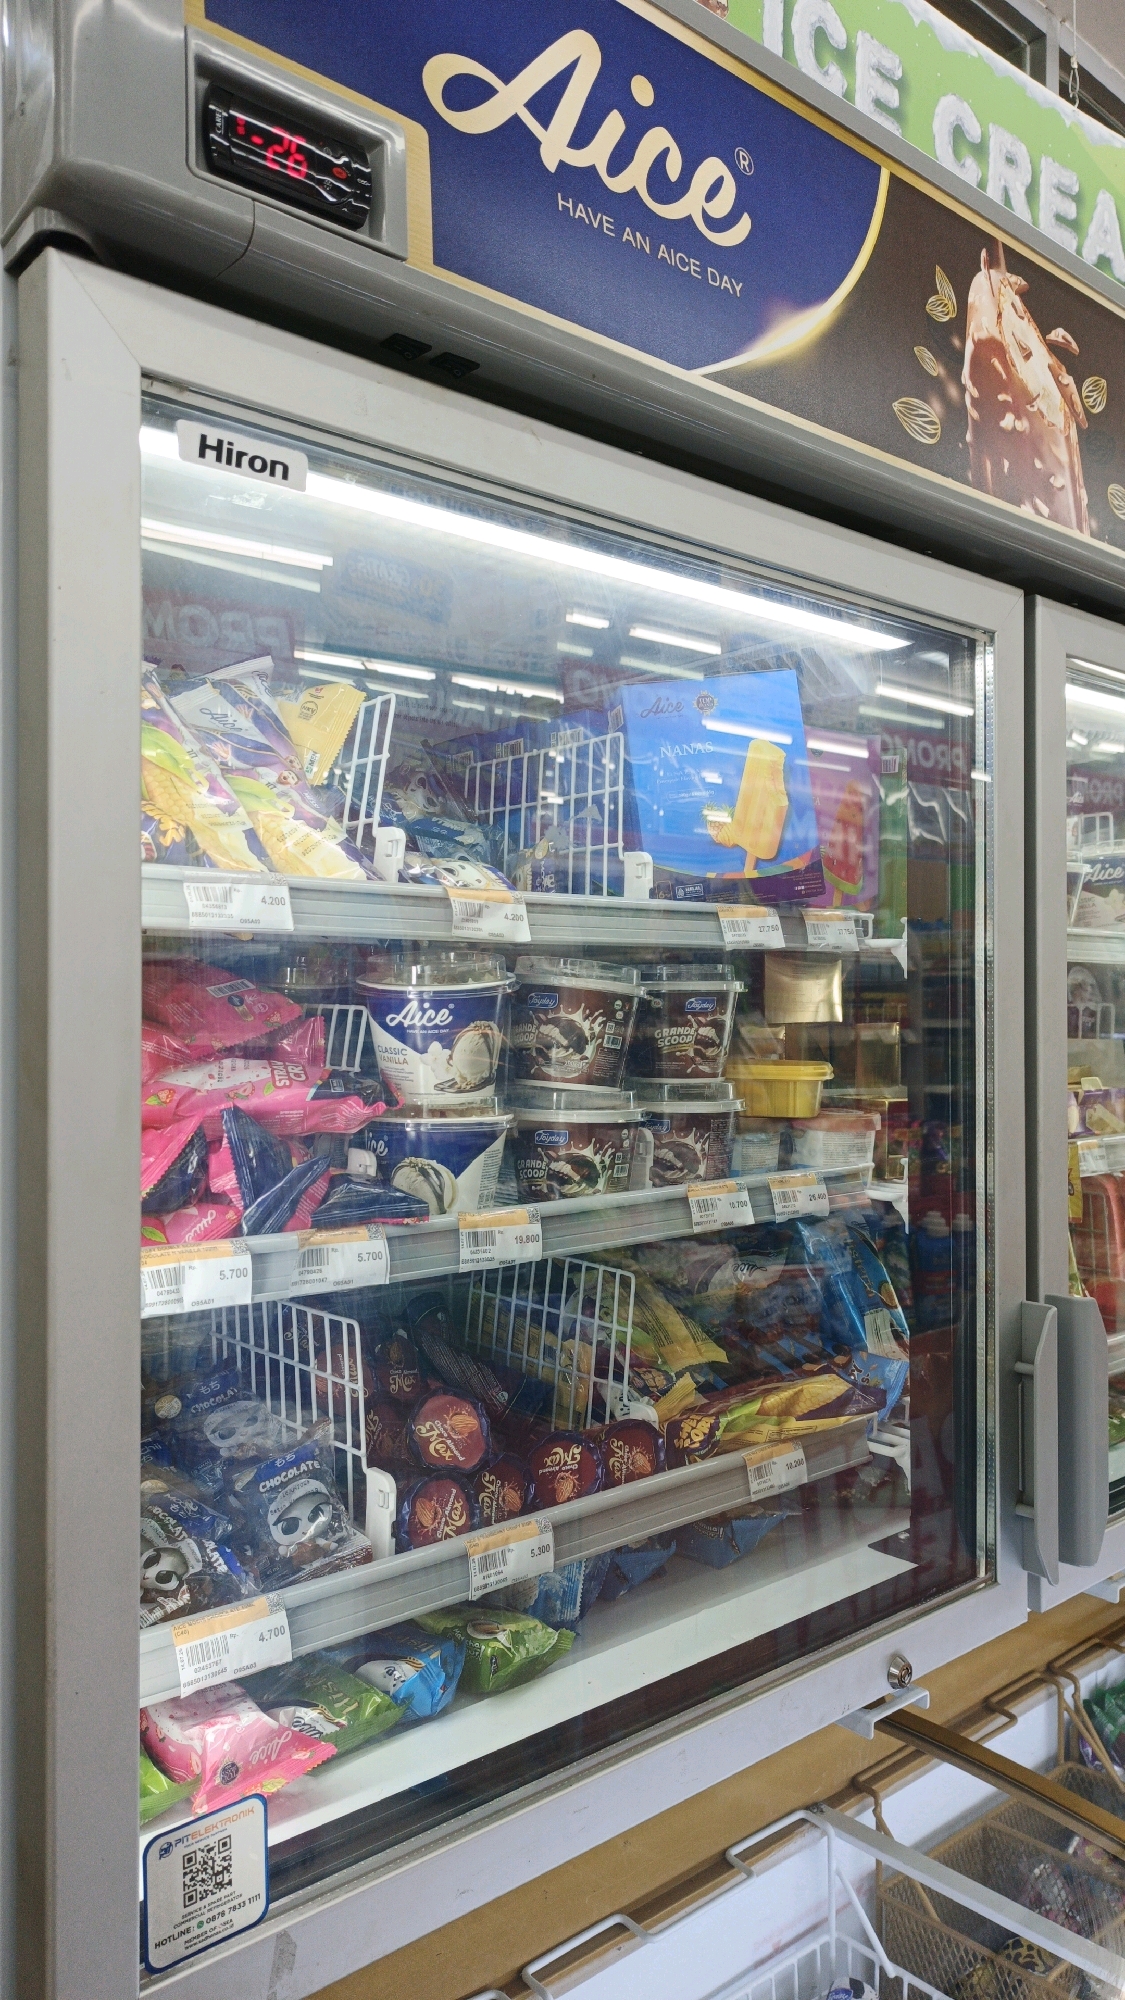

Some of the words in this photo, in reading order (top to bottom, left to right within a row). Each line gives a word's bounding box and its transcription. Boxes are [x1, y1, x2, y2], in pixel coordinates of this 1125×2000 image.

[763, 0, 903, 138] ICE
[422, 29, 751, 247] Aice
[557, 193, 615, 237] HAVE
[622, 227, 650, 254] AN
[658, 244, 702, 279] AICE
[707, 267, 743, 297] DAY
[198, 434, 289, 480] Hiron
[641, 697, 685, 718] Aice
[660, 742, 713, 758] NANAS
[261, 896, 286, 906] 4.200
[386, 1001, 453, 1028] Aice
[655, 1026, 696, 1039] GRANDE
[657, 1035, 693, 1048] SCOOP
[378, 1045, 408, 1057] CLASSIC
[379, 1056, 409, 1067] VANILLA
[517, 1158, 547, 1170] GRANDE
[519, 1168, 546, 1180] SCOOP
[514, 1233, 540, 1244] 19.800
[357, 1251, 383, 1262] 5.700
[219, 1267, 248, 1280] 5.700
[416, 1421, 454, 1461] Max
[434, 1420, 448, 1438] Choco
[445, 1437, 466, 1461] Almond
[274, 1453, 296, 1468] もち
[544, 1443, 582, 1467] Max
[259, 1459, 321, 1493] CHOCOLATE
[436, 1517, 446, 1539] Choco
[444, 1488, 457, 1516] Almond
[530, 1544, 551, 1558] 5.300
[258, 1625, 286, 1643] 4.700
[250, 1730, 293, 1766] Aice
[174, 1806, 255, 1849] PITELEKTRONIK
[181, 1906, 201, 1920] SERVICE
[207, 1897, 223, 1908] SPARE
[223, 1890, 236, 1900] PART
[154, 1926, 195, 1950] HOTLINE:
[228, 1900, 247, 1914] 7833
[173, 1911, 206, 1930] COMMERCIAL
[183, 1930, 208, 1946] MEMBER
